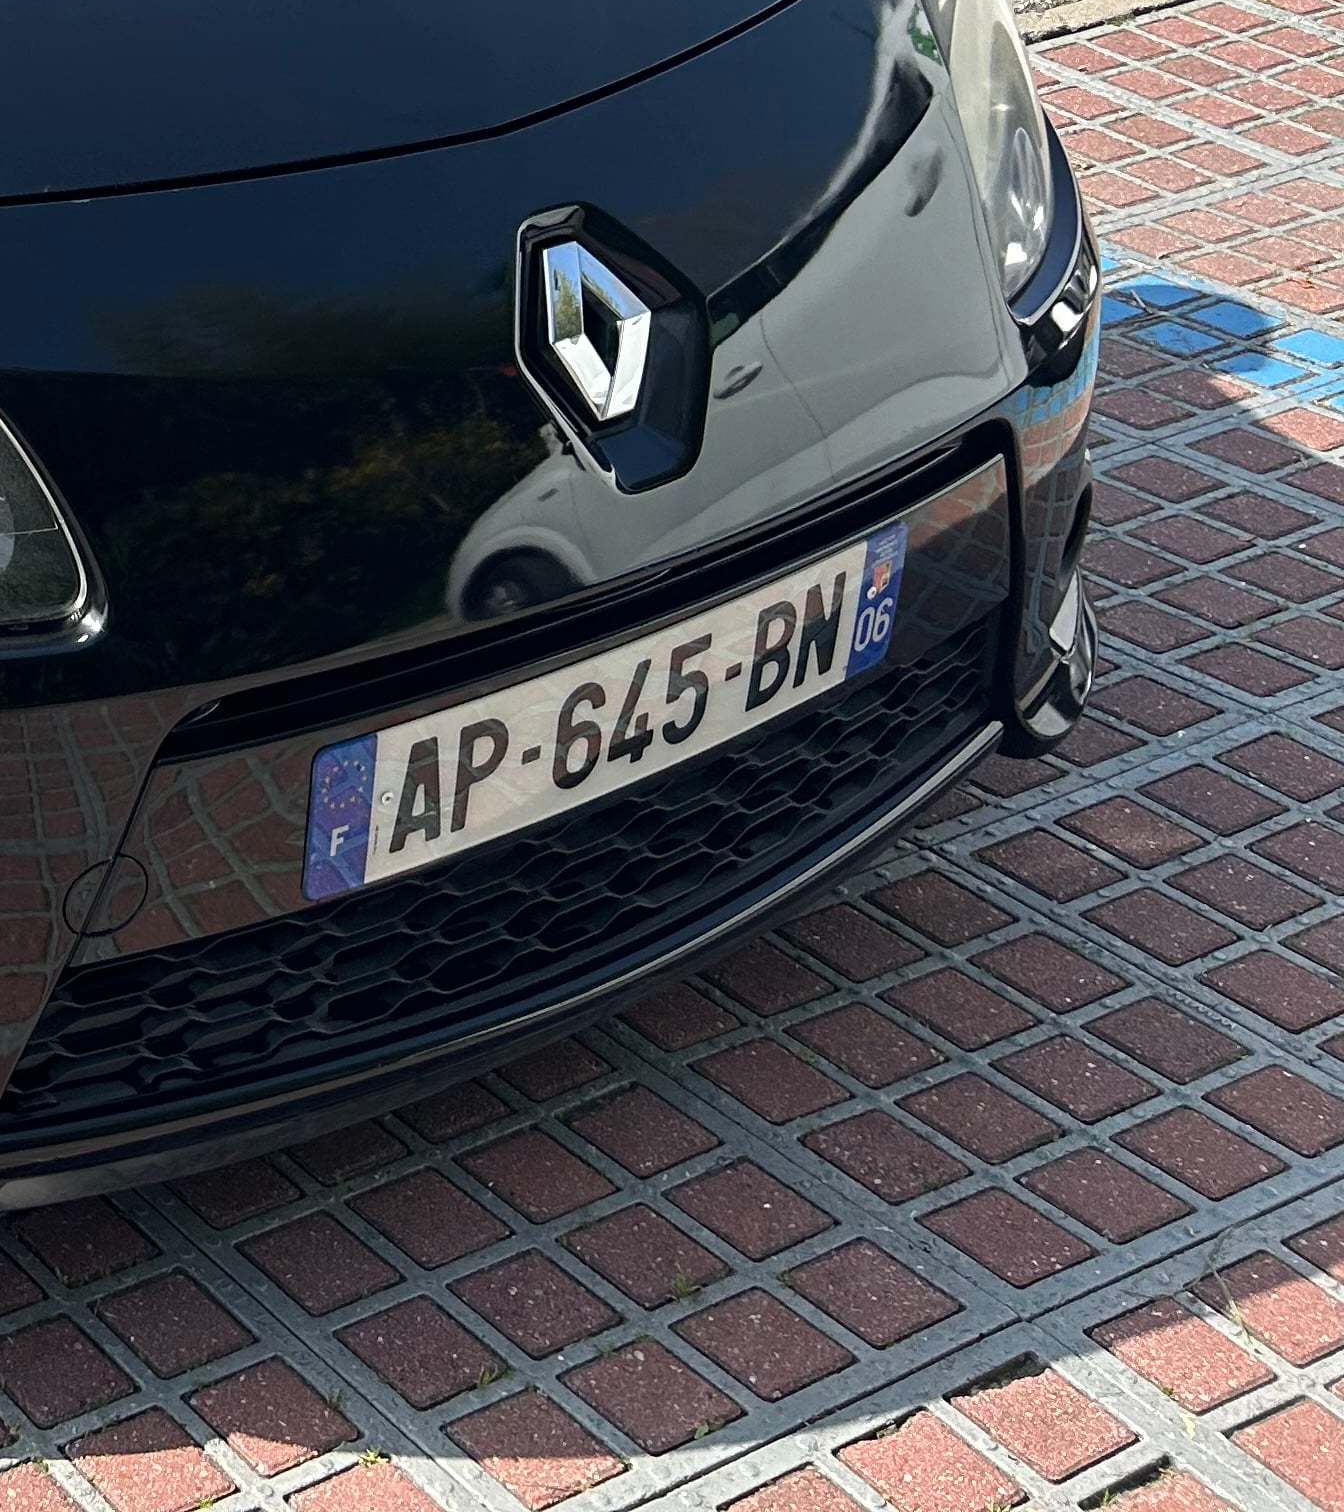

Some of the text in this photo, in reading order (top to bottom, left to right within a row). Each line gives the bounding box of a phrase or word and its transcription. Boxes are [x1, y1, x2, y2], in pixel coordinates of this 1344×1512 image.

[328, 824, 350, 858] F
[388, 571, 848, 854] AP-645-BN
[853, 596, 894, 653] 06
